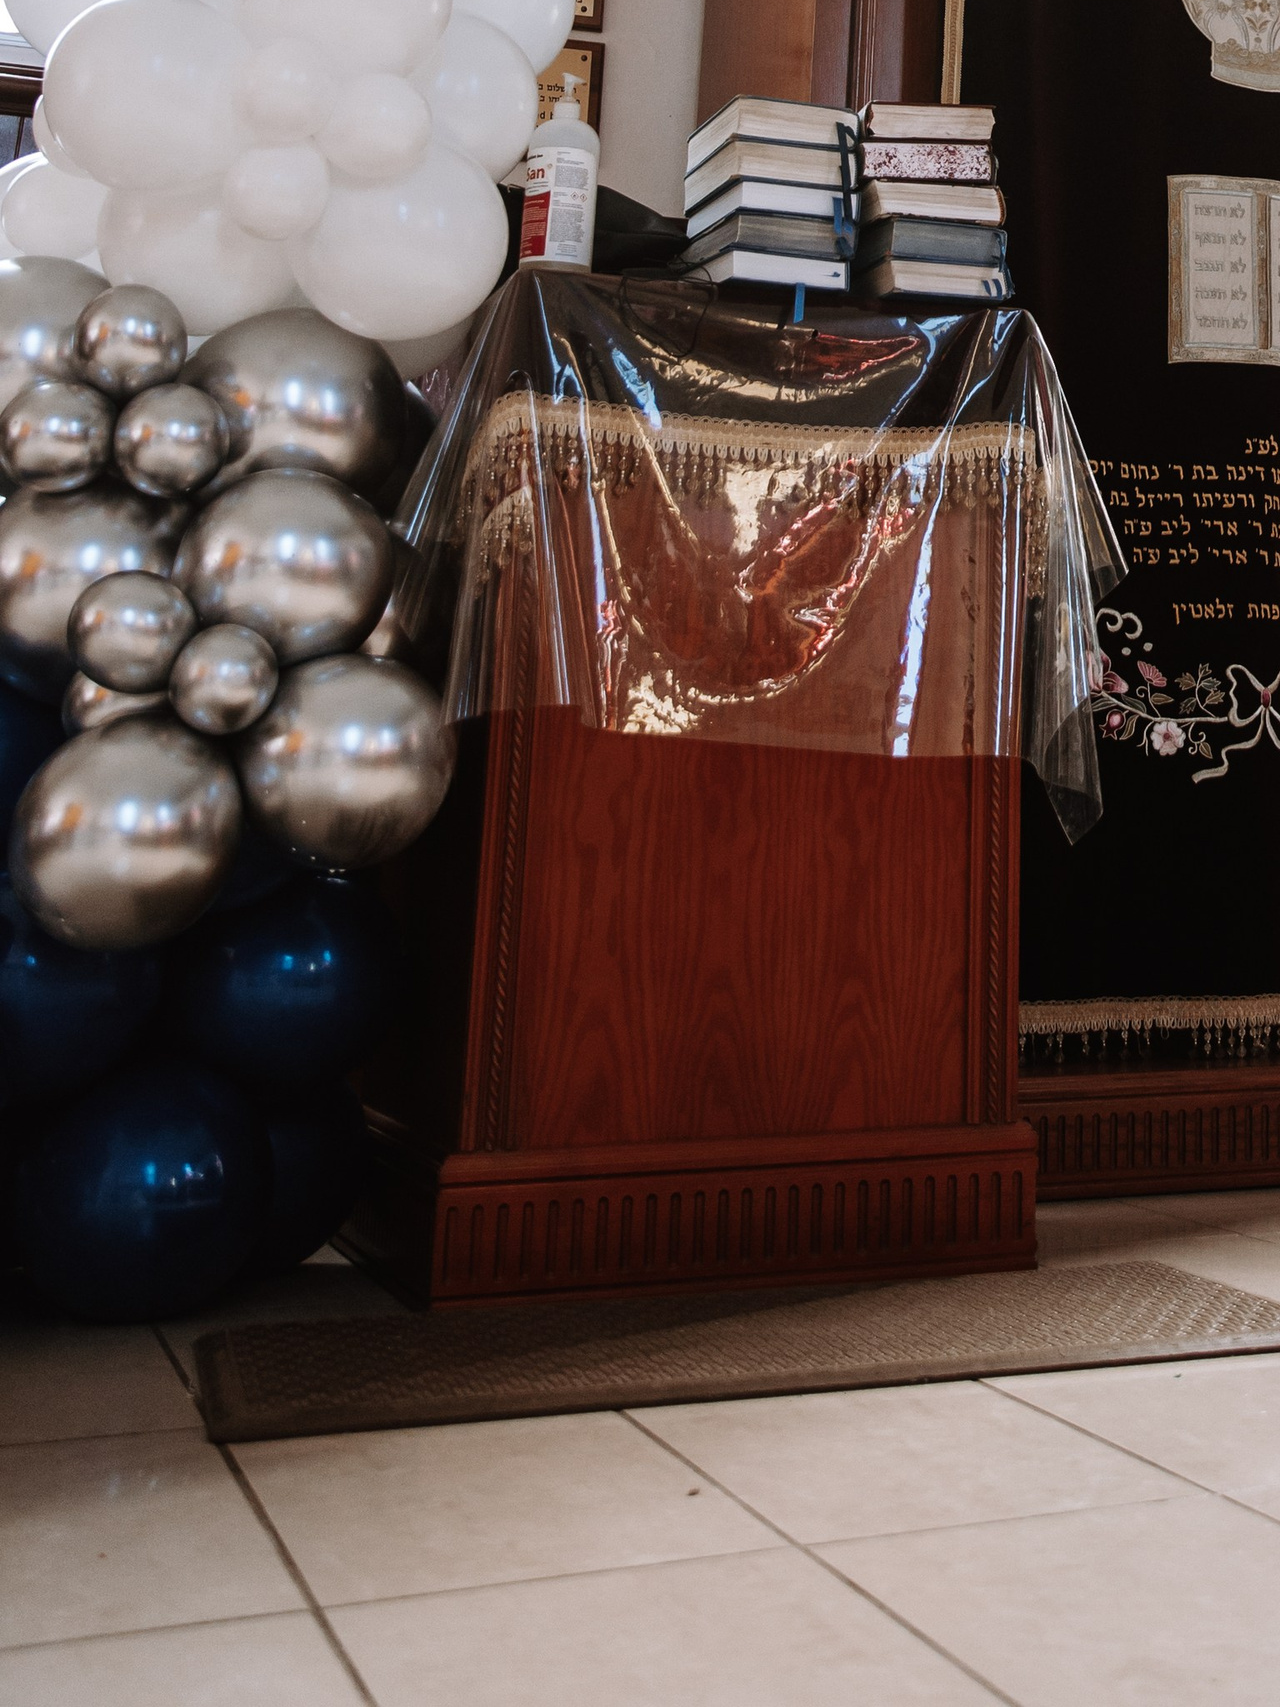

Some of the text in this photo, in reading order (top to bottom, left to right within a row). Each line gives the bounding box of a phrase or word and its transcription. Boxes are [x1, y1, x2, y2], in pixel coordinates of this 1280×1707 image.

[1089, 459, 1114, 477] יוס
[1120, 461, 1160, 481] נחום
[1191, 464, 1219, 481] בת
[1226, 464, 1265, 482] דינה
[1109, 489, 1130, 507] בת
[1134, 486, 1184, 508] רייזל
[1192, 491, 1256, 509] ורעיתו
[1160, 513, 1192, 536] ליב
[1168, 542, 1200, 565] ליב
[1172, 597, 1234, 626] זלאטין
